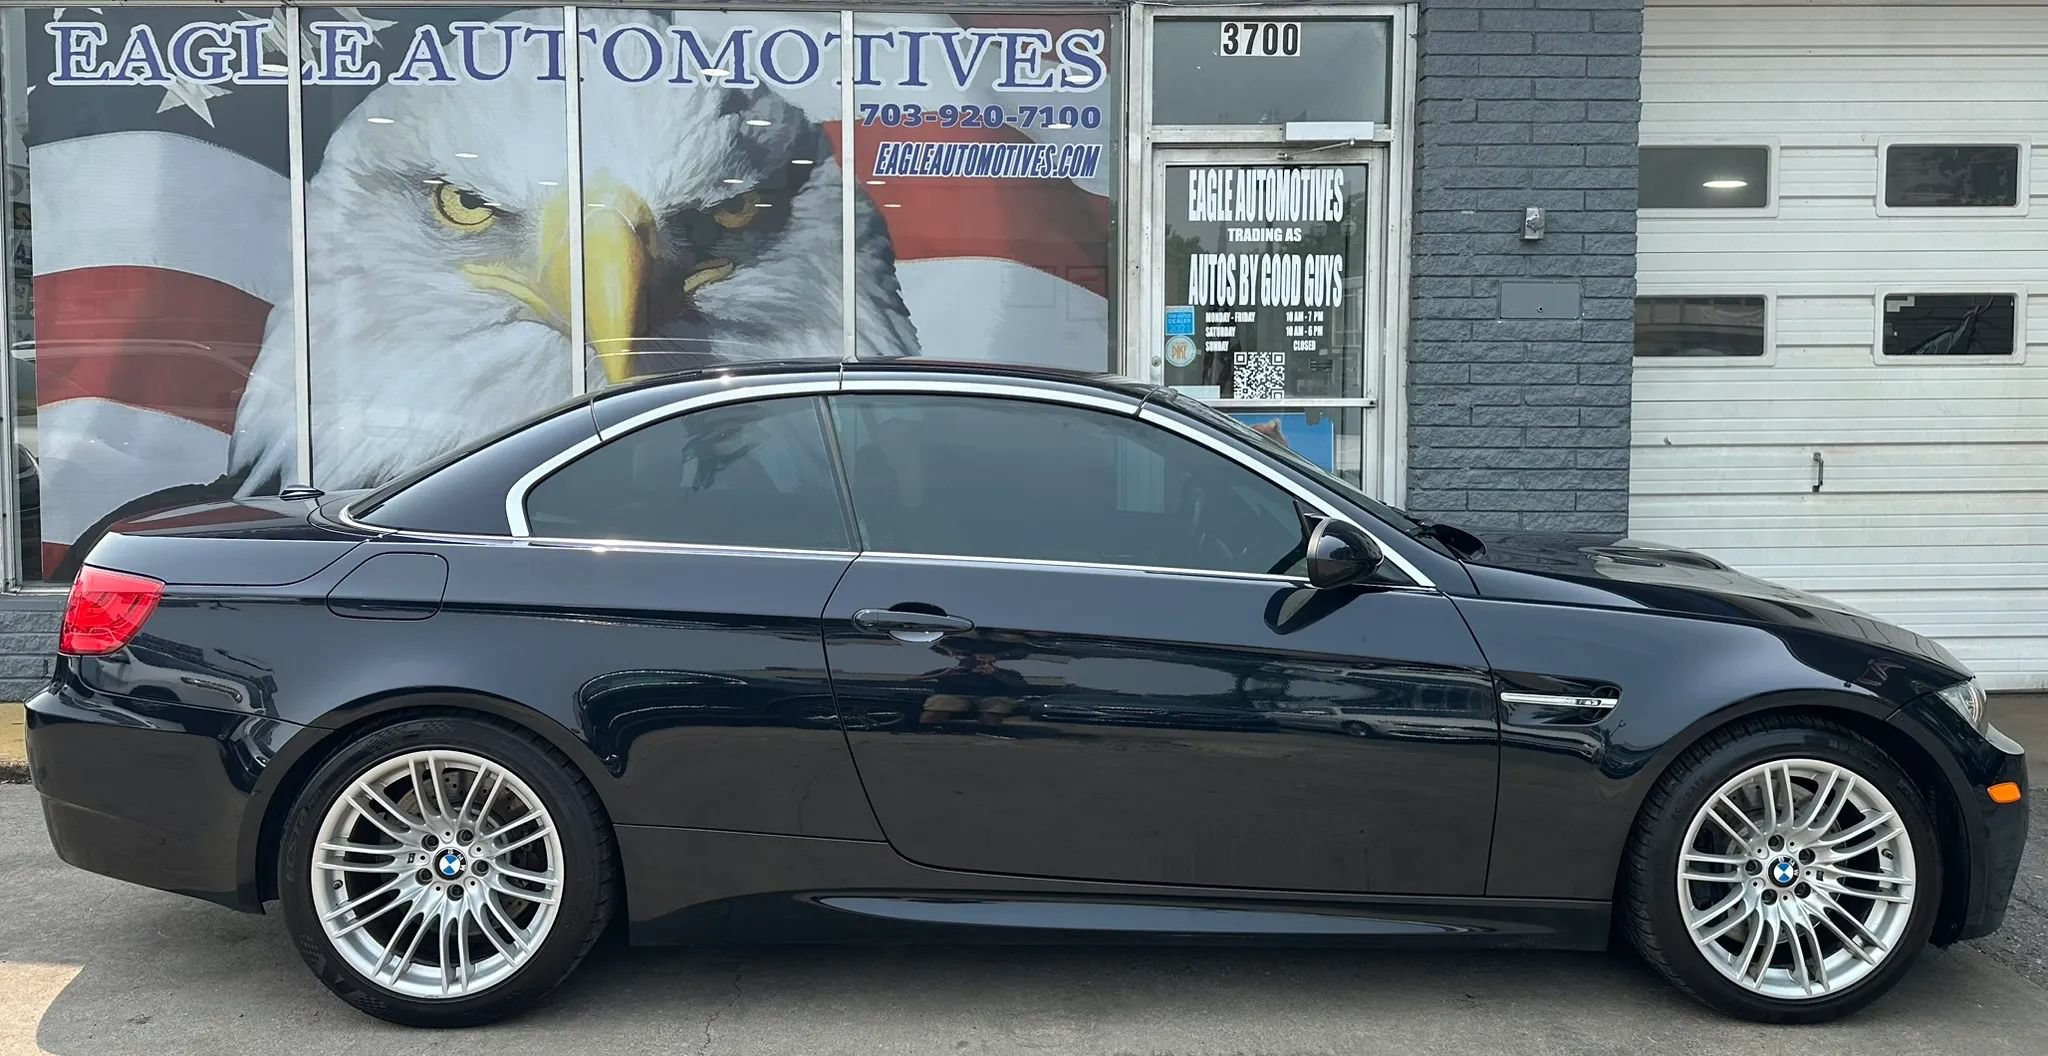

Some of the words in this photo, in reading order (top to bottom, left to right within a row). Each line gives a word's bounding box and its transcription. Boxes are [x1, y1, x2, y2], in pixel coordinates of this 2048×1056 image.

[1223, 22, 1298, 56] 3700
[49, 20, 381, 86] EAGLE
[389, 22, 1109, 92] AUTOMOTIVES
[859, 103, 1102, 129] 703-920-7100
[873, 142, 1101, 179] EAGLEAUTOMOTIVES.COM
[1188, 168, 1233, 222] EAGLE
[1235, 168, 1344, 222] AUTOMOTIVES
[1227, 227, 1283, 242] TRADING
[1285, 227, 1302, 242] AS
[1188, 253, 1236, 306] AUTOS
[1238, 253, 1259, 306] BY
[1260, 253, 1302, 307] GOOD
[1303, 253, 1343, 307] GUYS
[1205, 311, 1231, 323] MONDAY
[1234, 311, 1256, 323] FRIDAY
[1286, 311, 1294, 322] 10
[1294, 311, 1304, 322] AM
[1308, 311, 1312, 322] 7
[1313, 311, 1324, 322] PM
[1205, 326, 1236, 338] SATURDAY
[1286, 325, 1294, 337] 10
[1294, 326, 1304, 337] AM
[1308, 325, 1313, 337] 6
[1313, 325, 1324, 337] PM
[1205, 341, 1230, 352] SUNDAY
[1293, 340, 1316, 352] CLOSED
